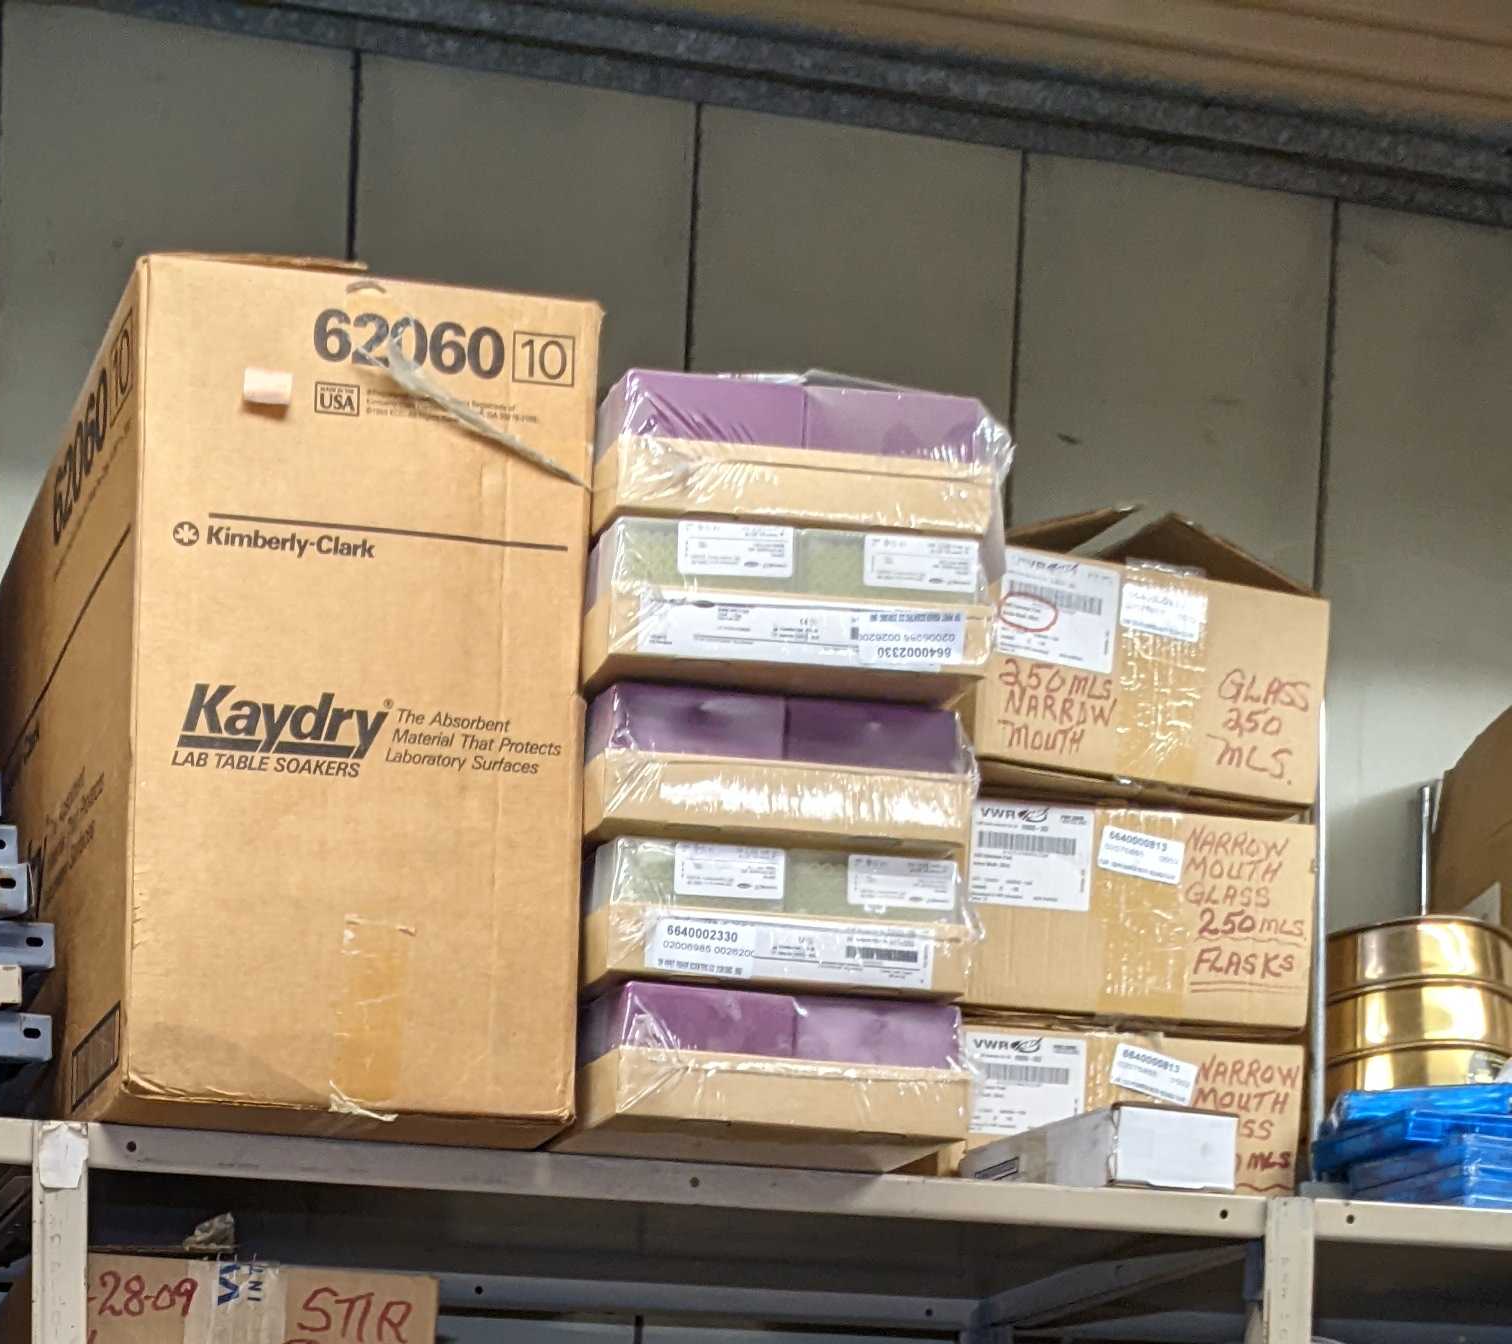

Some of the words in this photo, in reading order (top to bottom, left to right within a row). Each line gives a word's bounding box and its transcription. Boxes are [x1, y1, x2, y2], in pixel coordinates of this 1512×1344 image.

[313, 308, 505, 380] 62060
[520, 338, 568, 381] 10
[319, 393, 356, 412] USA
[52, 372, 110, 545] 62060
[206, 526, 375, 559] Kimberly-Clark
[998, 657, 1065, 695] 250
[1218, 668, 1310, 712] GLASS
[1005, 682, 1117, 727] NARROW
[181, 683, 389, 758] Kaydry
[397, 708, 426, 726] The
[430, 711, 511, 733] Absorbent
[1223, 708, 1282, 737] 250
[392, 729, 456, 749] Material
[460, 732, 495, 752] That
[499, 737, 561, 756] Protects
[998, 719, 1084, 755] MOUTH
[171, 750, 208, 768] LAB
[214, 752, 269, 773] TABLE
[272, 756, 361, 778] SOAKERS
[385, 748, 466, 771] Laboratory
[471, 755, 540, 776] Surfaces
[979, 807, 1016, 820] VWR
[1188, 826, 1289, 858] NARROW
[1186, 858, 1282, 880] MOUTH
[1185, 885, 1271, 909] GLASS
[666, 925, 738, 943] 6640002330
[1198, 908, 1255, 937] 250
[1193, 946, 1294, 977] FLASKS
[973, 1039, 1010, 1052] VWR
[1196, 1056, 1301, 1086] NARROW
[1194, 1089, 1289, 1115] MOUTH
[89, 1271, 198, 1317] -28-09
[297, 1286, 413, 1344] STIR
